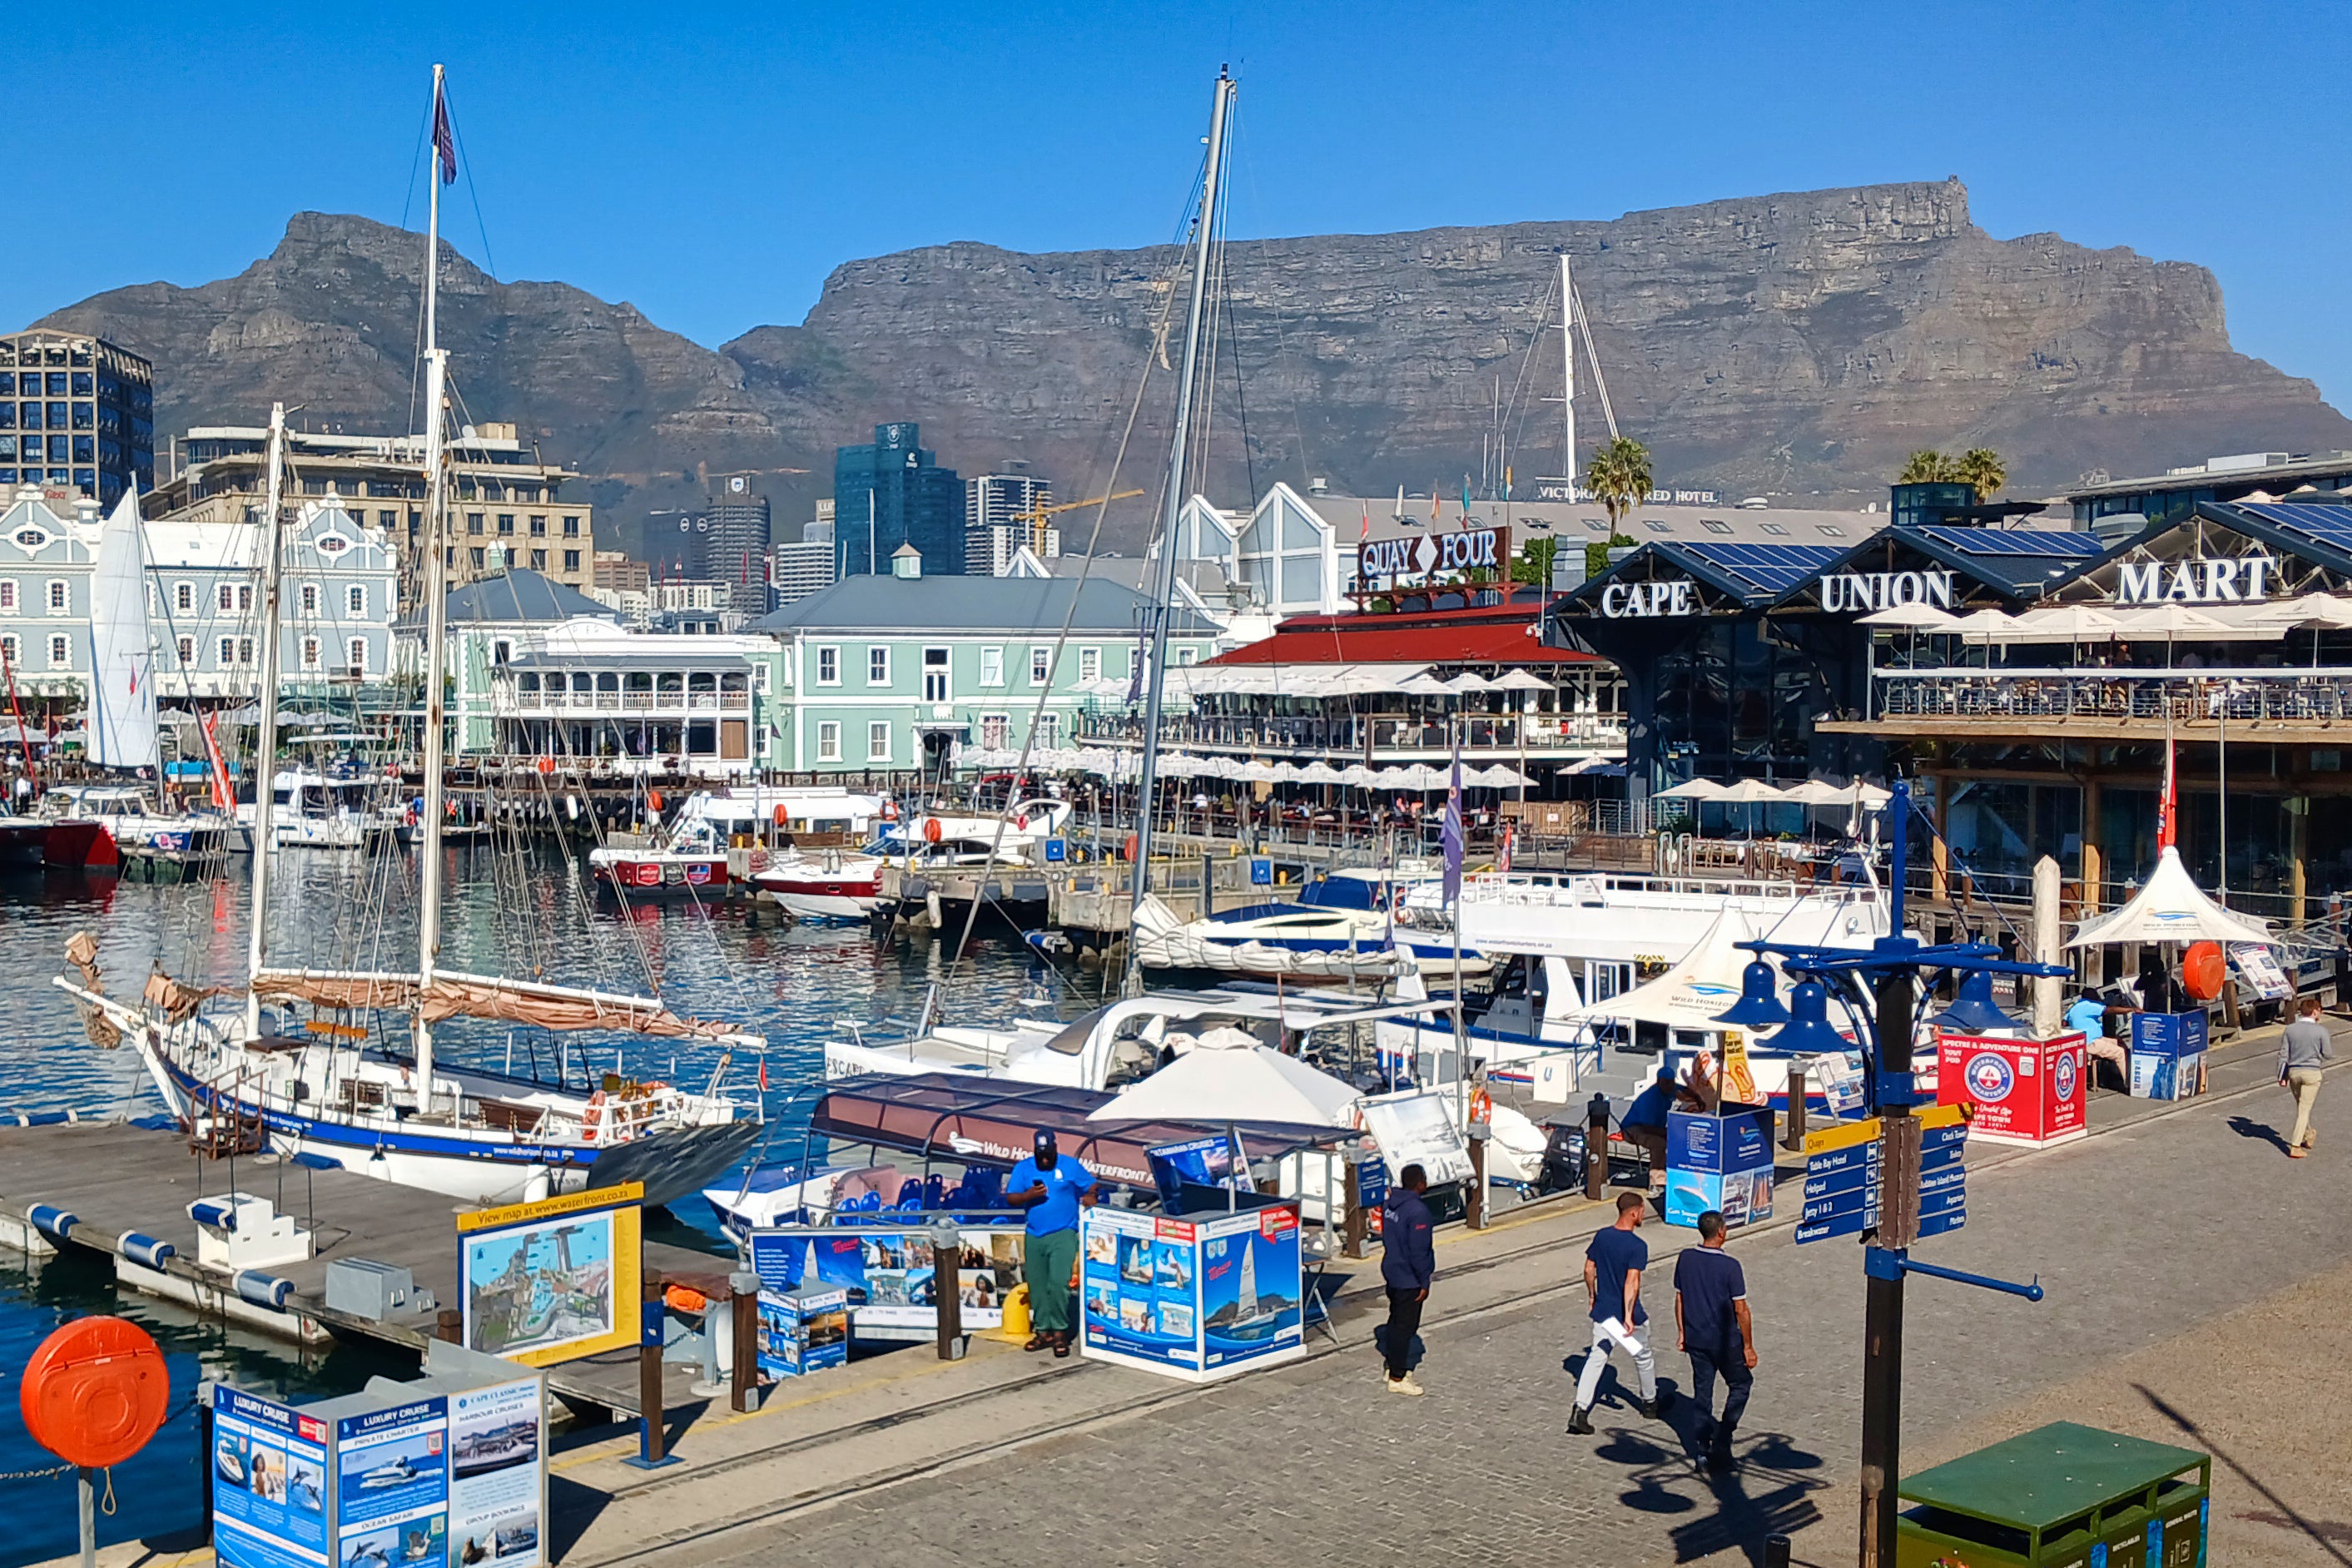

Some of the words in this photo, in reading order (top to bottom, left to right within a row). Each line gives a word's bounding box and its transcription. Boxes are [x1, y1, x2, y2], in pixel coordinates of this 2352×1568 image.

[1675, 490, 1718, 503] HOTEL
[1362, 539, 1413, 576] QUAY
[1441, 530, 1497, 569] FOUR
[1602, 581, 1697, 618] CAPE
[1820, 571, 1962, 613] UNION
[2116, 556, 2277, 604] MART
[1671, 995, 1693, 1004] WILD
[1942, 1040, 1971, 1049] SPECTRE
[1978, 1042, 2022, 1053] ADVENTURE
[2022, 1046, 2040, 1054] ONE
[1971, 1058, 2008, 1079] WATERFRONT
[1972, 1082, 2006, 1097] CHARTERS
[1973, 1114, 1986, 1122] APE
[1987, 1114, 2012, 1124] TOWN
[1808, 1139, 1824, 1149] Quays
[1942, 1132, 1954, 1142] Clock
[1954, 1129, 1967, 1139] Tower
[983, 1141, 1010, 1159] WILD
[1809, 1160, 1823, 1171] Table
[1823, 1158, 1832, 1170] Bay
[1832, 1153, 1847, 1166] Hotel
[477, 1213, 501, 1225] View
[504, 1210, 522, 1222] map
[523, 1207, 533, 1217] at
[534, 1189, 628, 1214] www.waterfront.co.za
[1804, 1207, 1818, 1220] Jetty
[1828, 1201, 1833, 1212] 2
[1797, 1226, 1830, 1240] Breakwater
[234, 1394, 263, 1414] LUXURY
[262, 1405, 290, 1424] CRUISE
[364, 1410, 399, 1427] LUXURY
[399, 1403, 430, 1418] CRUISE
[354, 1433, 384, 1446] PRIVATE
[386, 1426, 420, 1440] CHARTER
[360, 1518, 387, 1530] OCEAN
[388, 1511, 414, 1524] SAFARI
